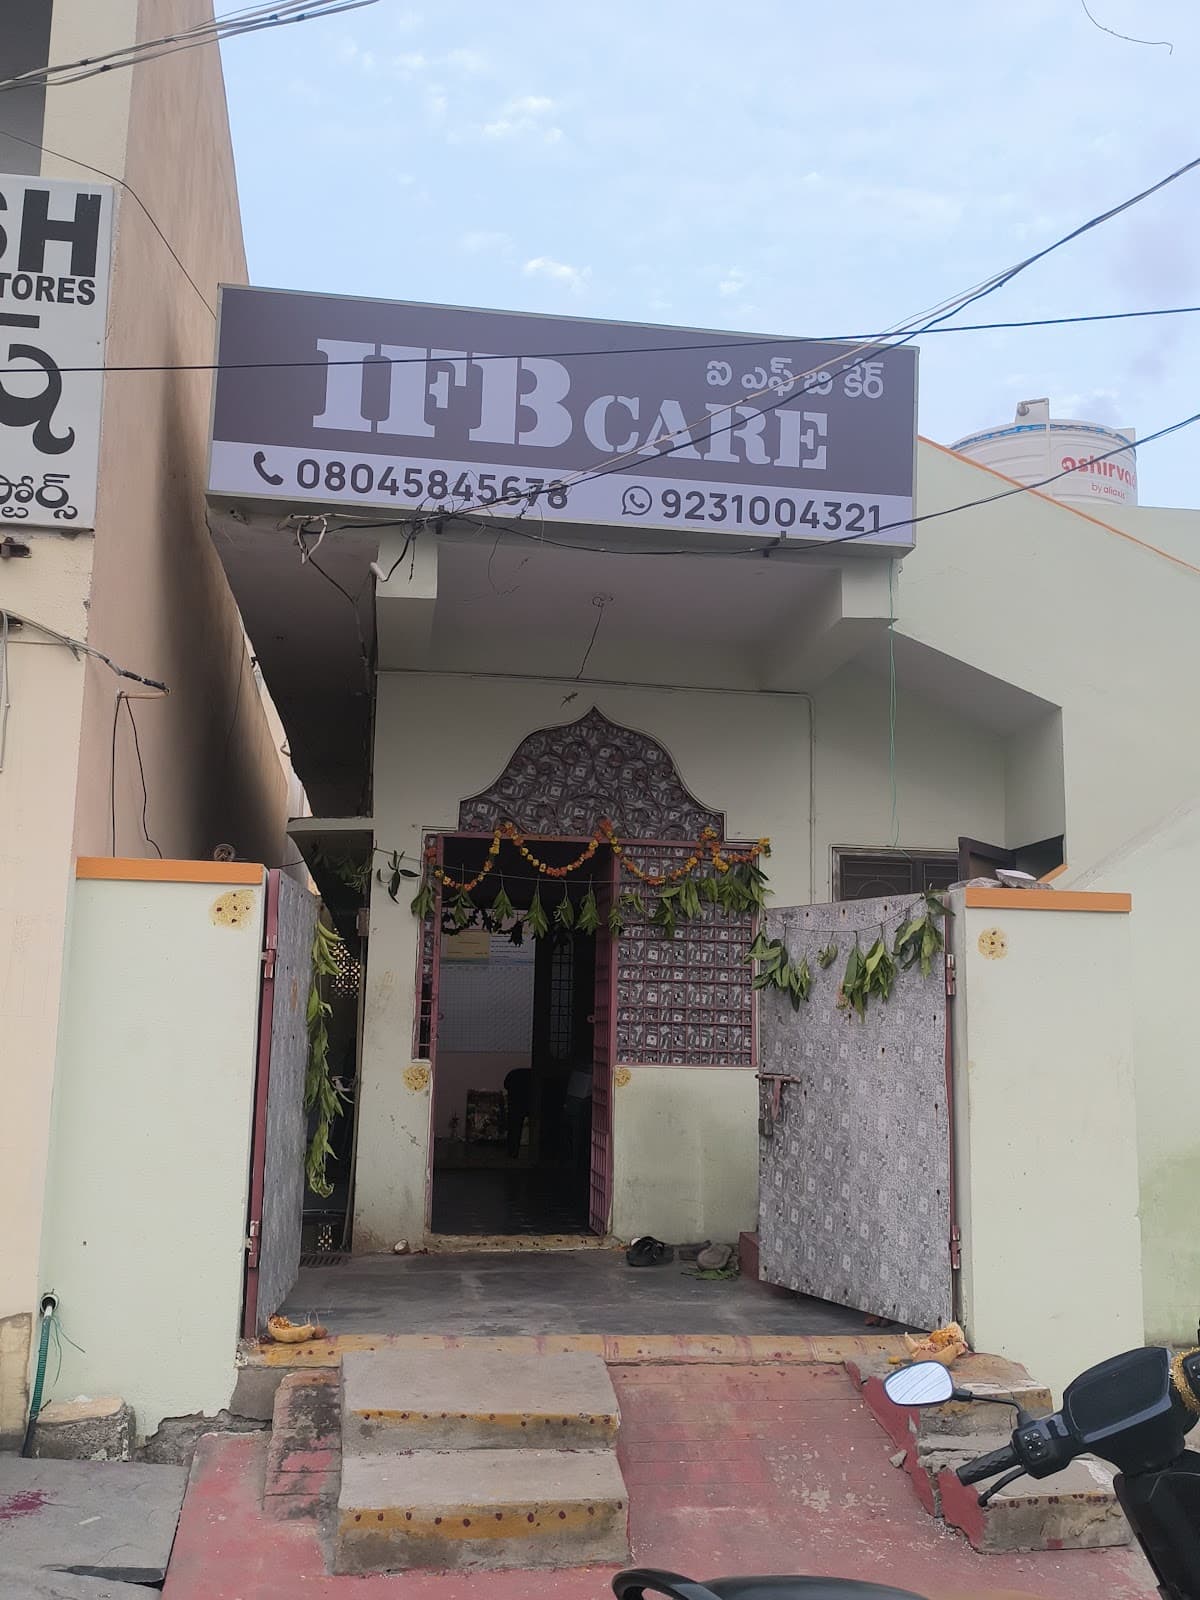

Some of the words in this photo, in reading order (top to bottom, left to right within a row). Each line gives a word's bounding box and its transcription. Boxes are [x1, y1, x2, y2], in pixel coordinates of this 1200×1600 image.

[0, 188, 102, 277] H
[312, 338, 573, 448] IFB
[583, 395, 829, 470] CARE
[296, 458, 570, 510] 08045845678
[661, 489, 881, 533] 9231004321
